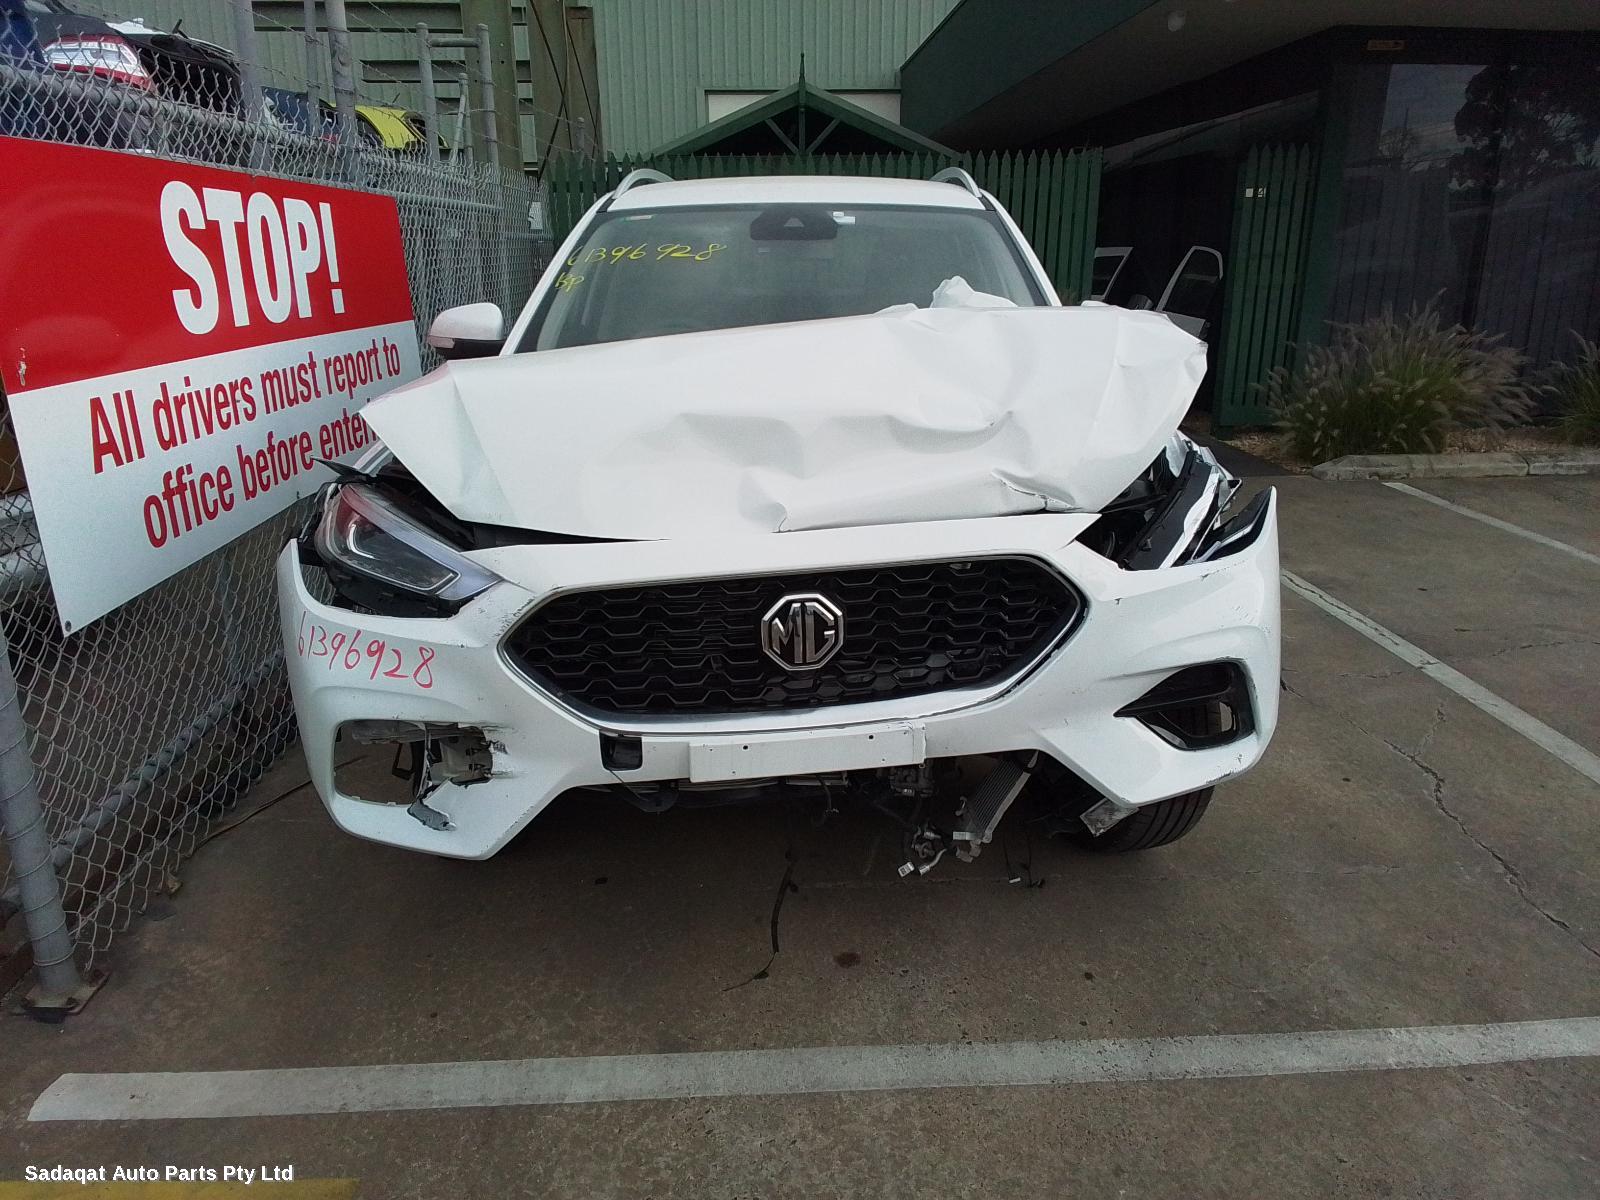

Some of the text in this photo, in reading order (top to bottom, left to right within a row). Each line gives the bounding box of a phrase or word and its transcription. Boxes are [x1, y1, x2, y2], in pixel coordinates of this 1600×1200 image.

[160, 180, 344, 335] STOP!
[89, 337, 401, 474] All drivers must report to
[143, 462, 235, 549] office
[236, 429, 315, 500] before
[297, 610, 436, 689] 61396928
[771, 601, 836, 664] MG
